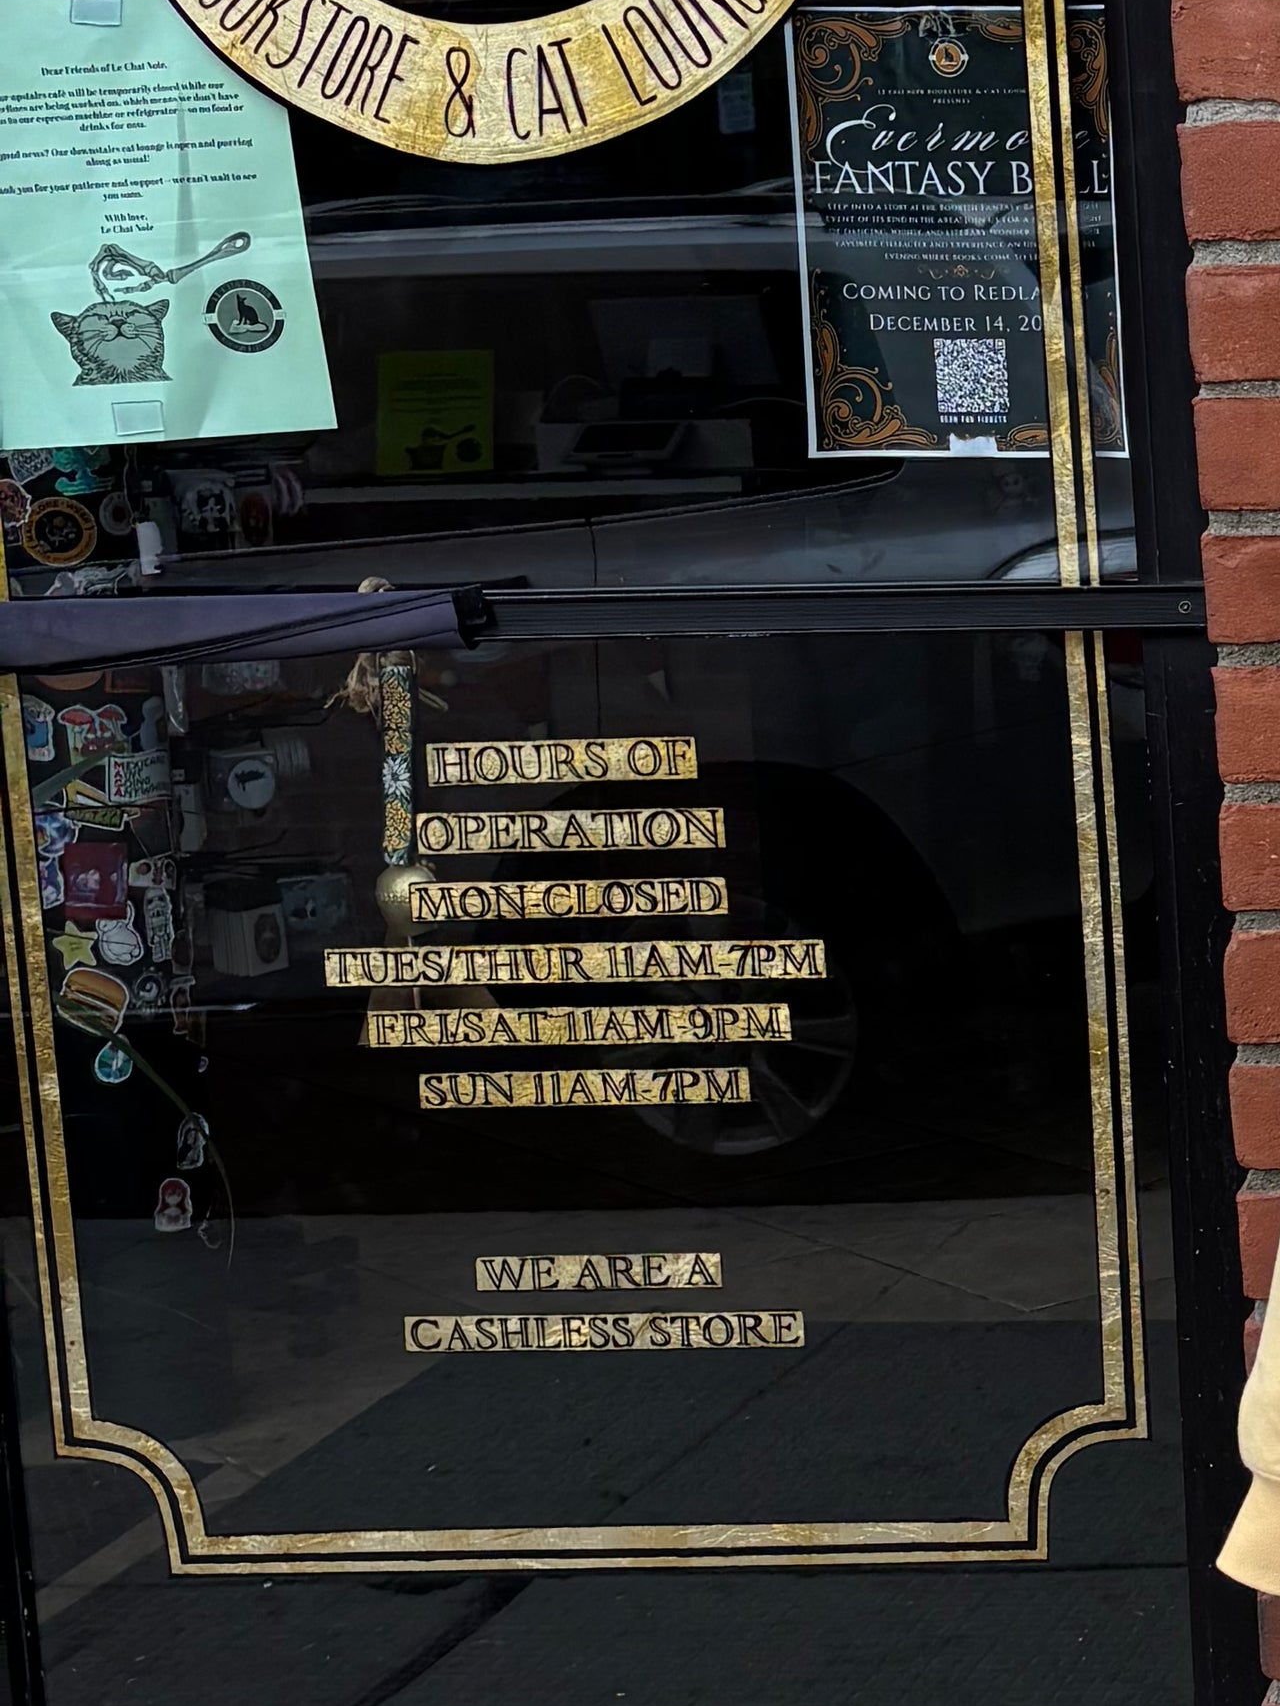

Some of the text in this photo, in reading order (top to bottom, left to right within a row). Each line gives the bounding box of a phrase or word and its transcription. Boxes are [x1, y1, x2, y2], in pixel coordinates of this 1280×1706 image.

[445, 47, 477, 139] &
[507, 37, 595, 141] CAT
[825, 104, 1091, 171] Evermoe
[813, 160, 1109, 195] FANTASY BL
[843, 283, 1041, 301] COMING TO REDLA
[869, 313, 1043, 332] DECEMBER 14, 20
[432, 739, 693, 785] HOURS OF
[418, 809, 721, 854] OPERATION
[413, 878, 723, 921] MON-CLOSED
[327, 941, 822, 985] TUES/THUR 11AM-7PM
[423, 1069, 743, 1106] SUN 11AM-7PM
[481, 1254, 720, 1291] WE ARE A
[408, 1312, 801, 1351] CASHLESS STORE
